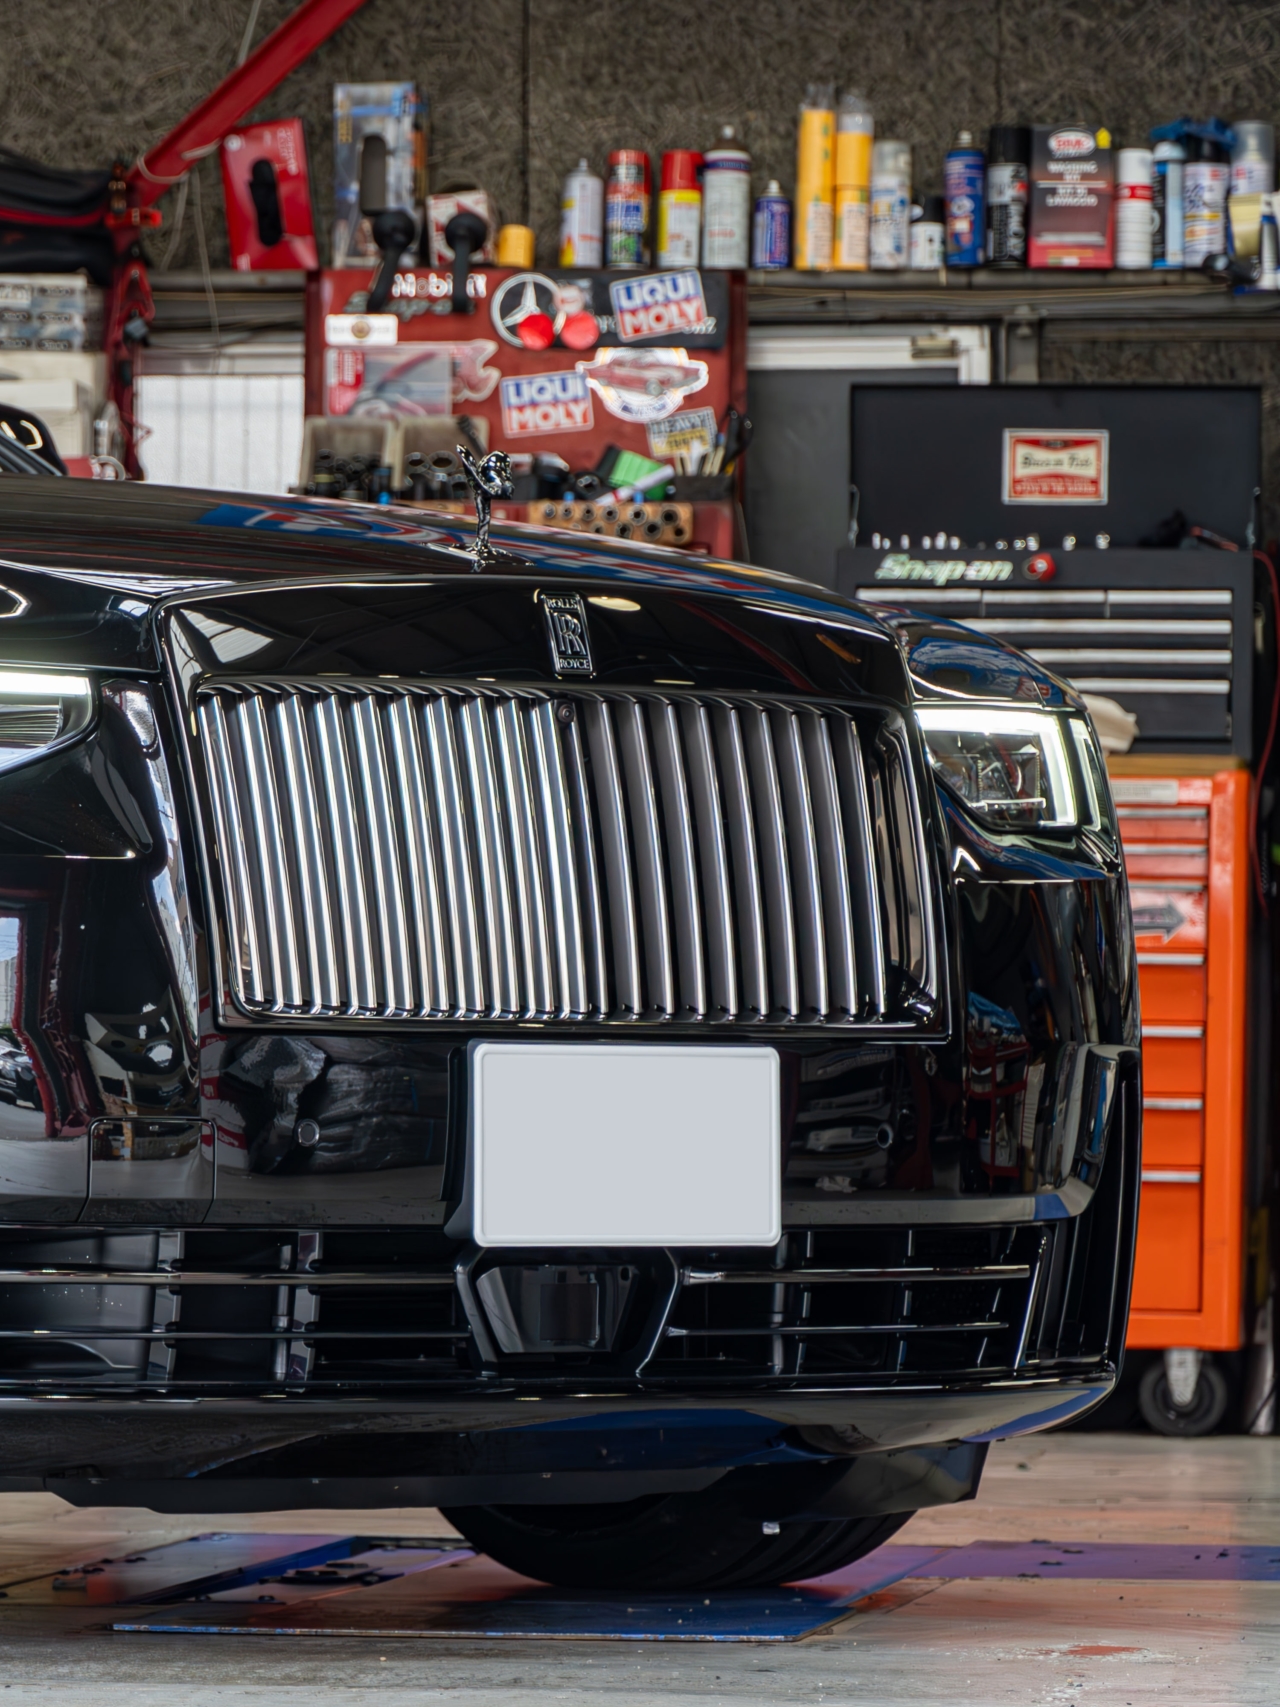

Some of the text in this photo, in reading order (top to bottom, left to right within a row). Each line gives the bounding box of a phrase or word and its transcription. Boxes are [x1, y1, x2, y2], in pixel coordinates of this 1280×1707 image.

[392, 273, 453, 297] Mobi
[620, 273, 696, 309] LIQUI
[623, 297, 699, 335] MOLY
[508, 375, 585, 404] LIQUI
[512, 401, 587, 430] MOLY
[547, 599, 578, 609] ROLLS
[559, 659, 590, 669] ROYCE
